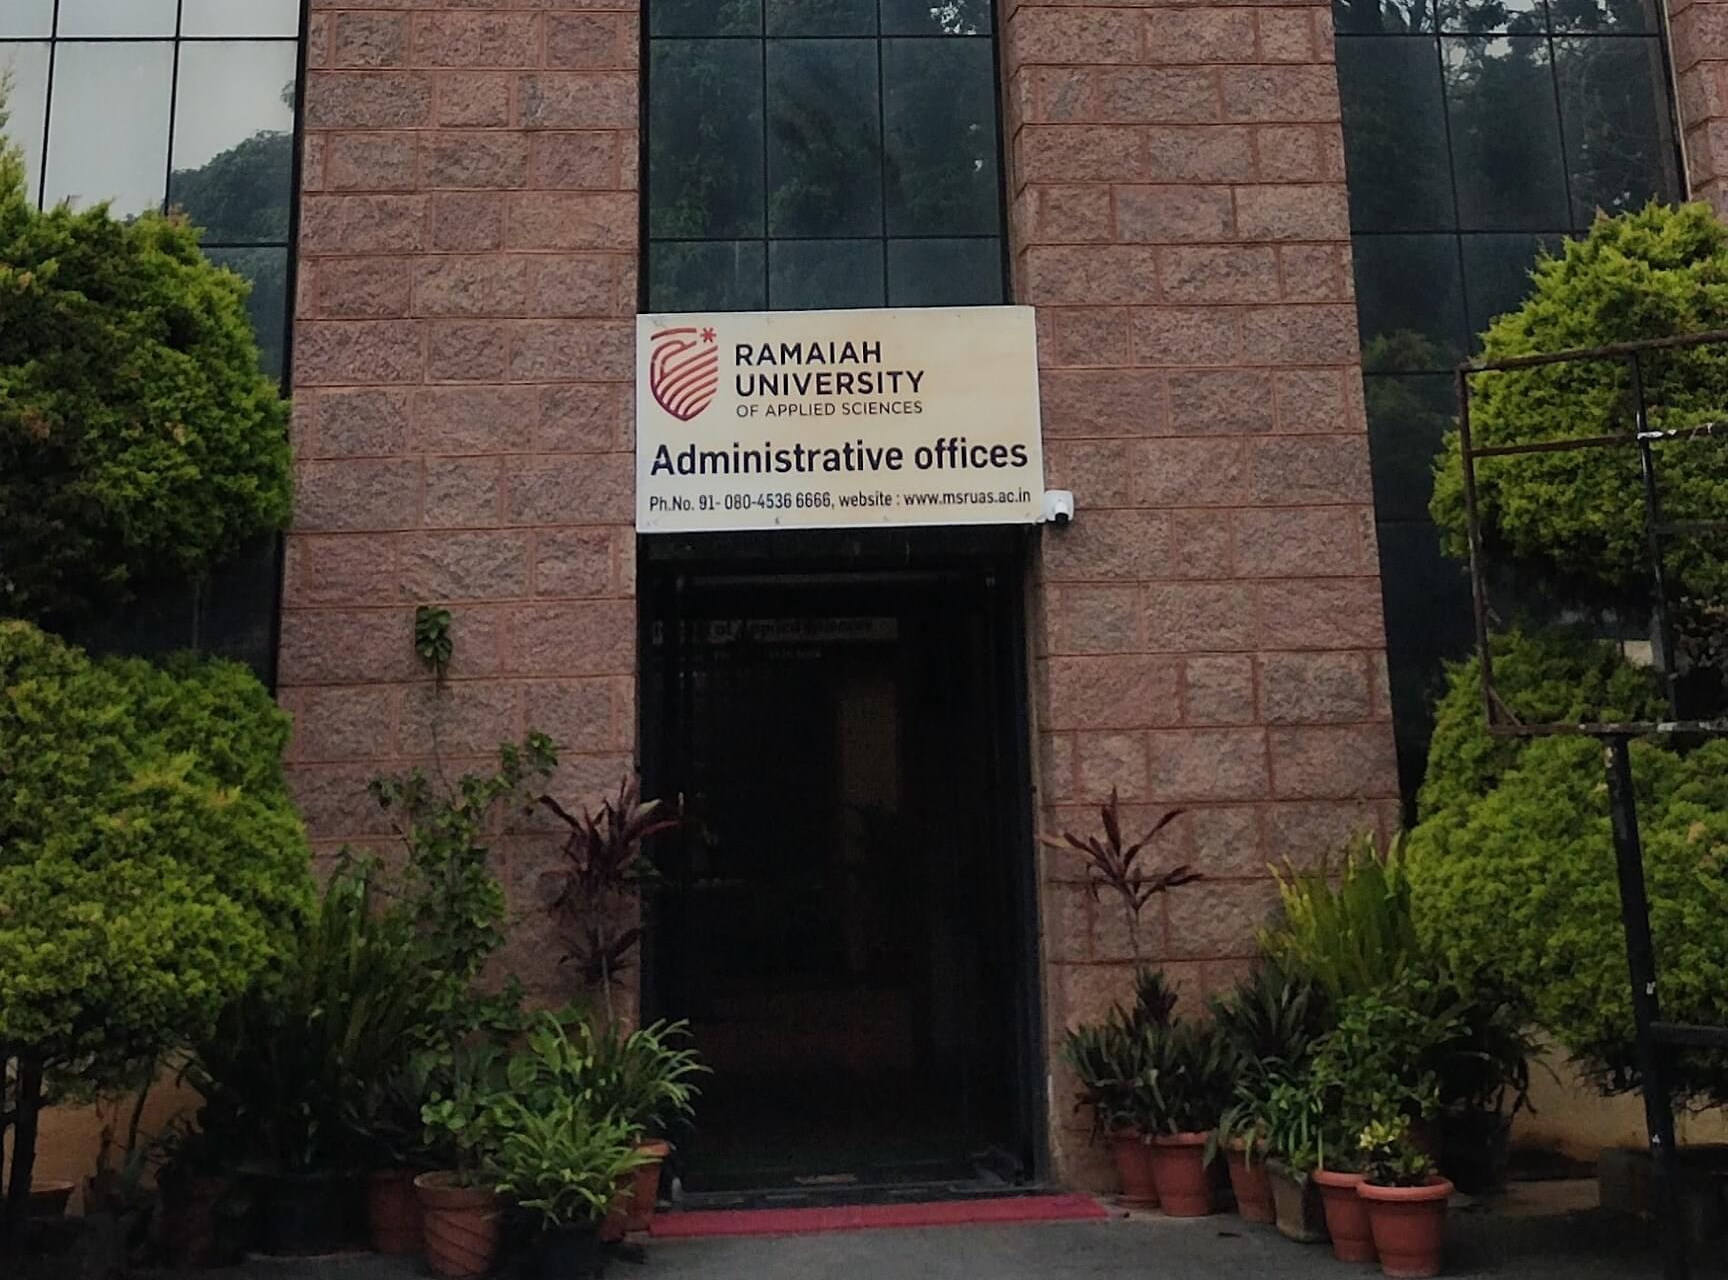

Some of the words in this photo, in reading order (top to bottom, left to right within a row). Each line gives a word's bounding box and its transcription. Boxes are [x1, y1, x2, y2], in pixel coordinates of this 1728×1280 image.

[735, 341, 882, 367] RAMAIAH
[735, 370, 925, 397] UNIVERSITY
[736, 404, 759, 418] OF
[765, 402, 836, 417] APPLIED
[841, 400, 923, 416] SCIENCES
[650, 439, 903, 476] Administrative
[914, 436, 1028, 470] offices
[795, 491, 835, 510] 6666,
[838, 490, 893, 507] website
[903, 486, 1031, 506] www.msruas.ac.in
